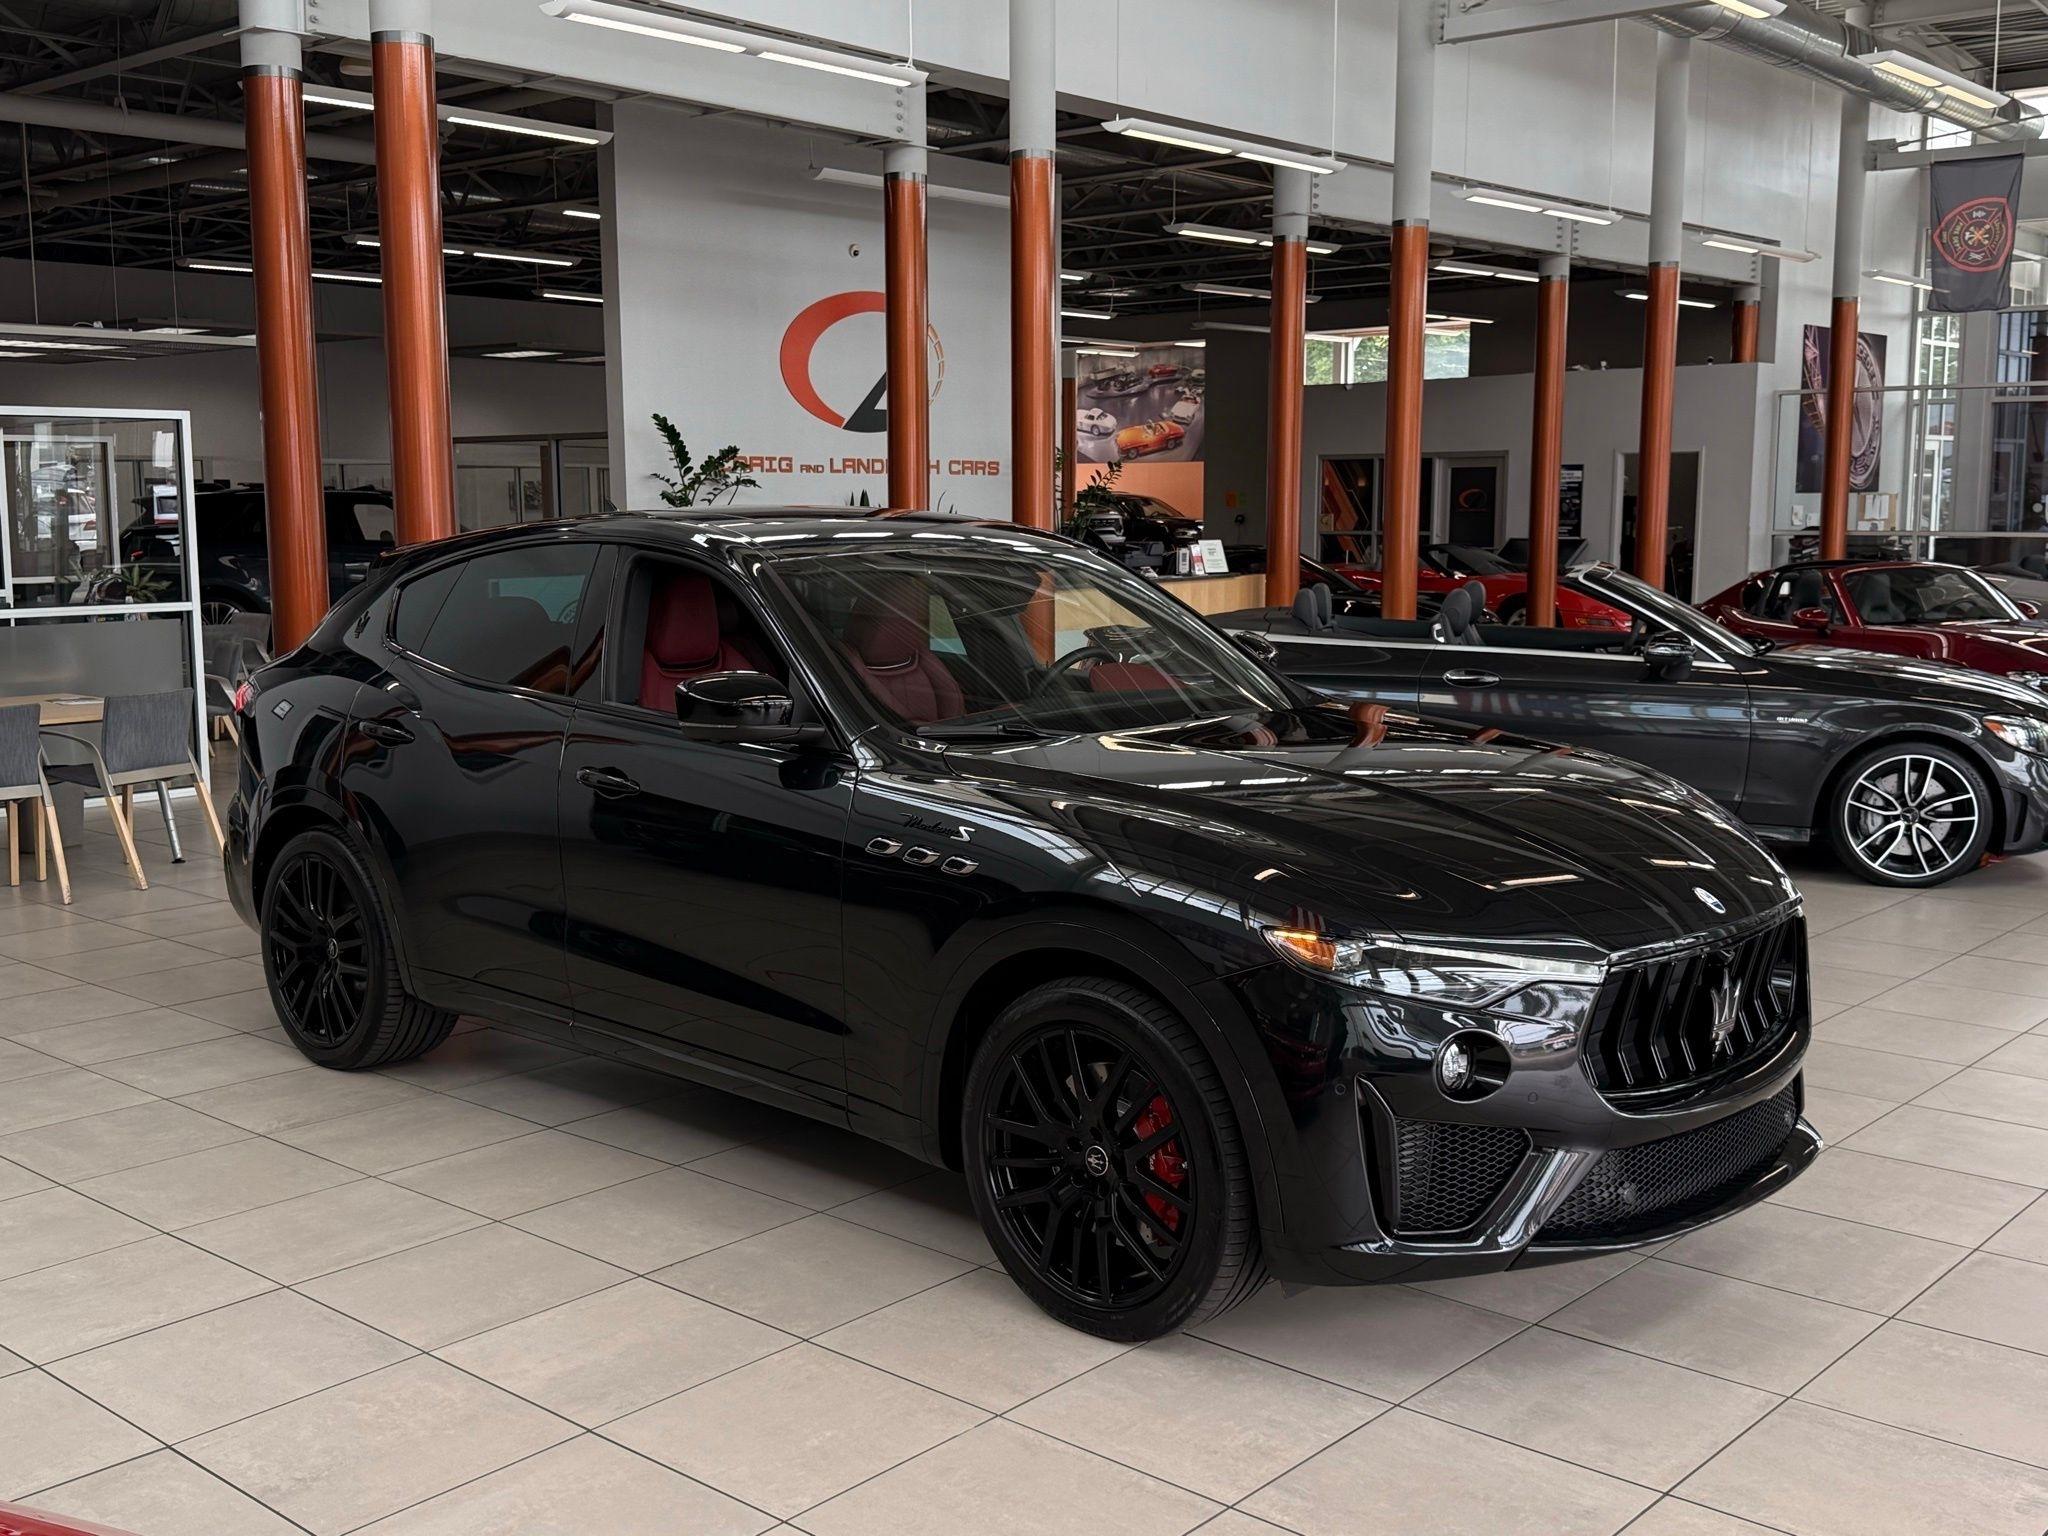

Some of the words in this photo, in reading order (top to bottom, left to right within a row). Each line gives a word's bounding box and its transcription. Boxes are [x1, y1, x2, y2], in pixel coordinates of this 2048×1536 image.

[799, 463, 825, 475] AND
[829, 457, 941, 475] LANDH
[949, 459, 1001, 476] CARS
[950, 825, 976, 843] S
